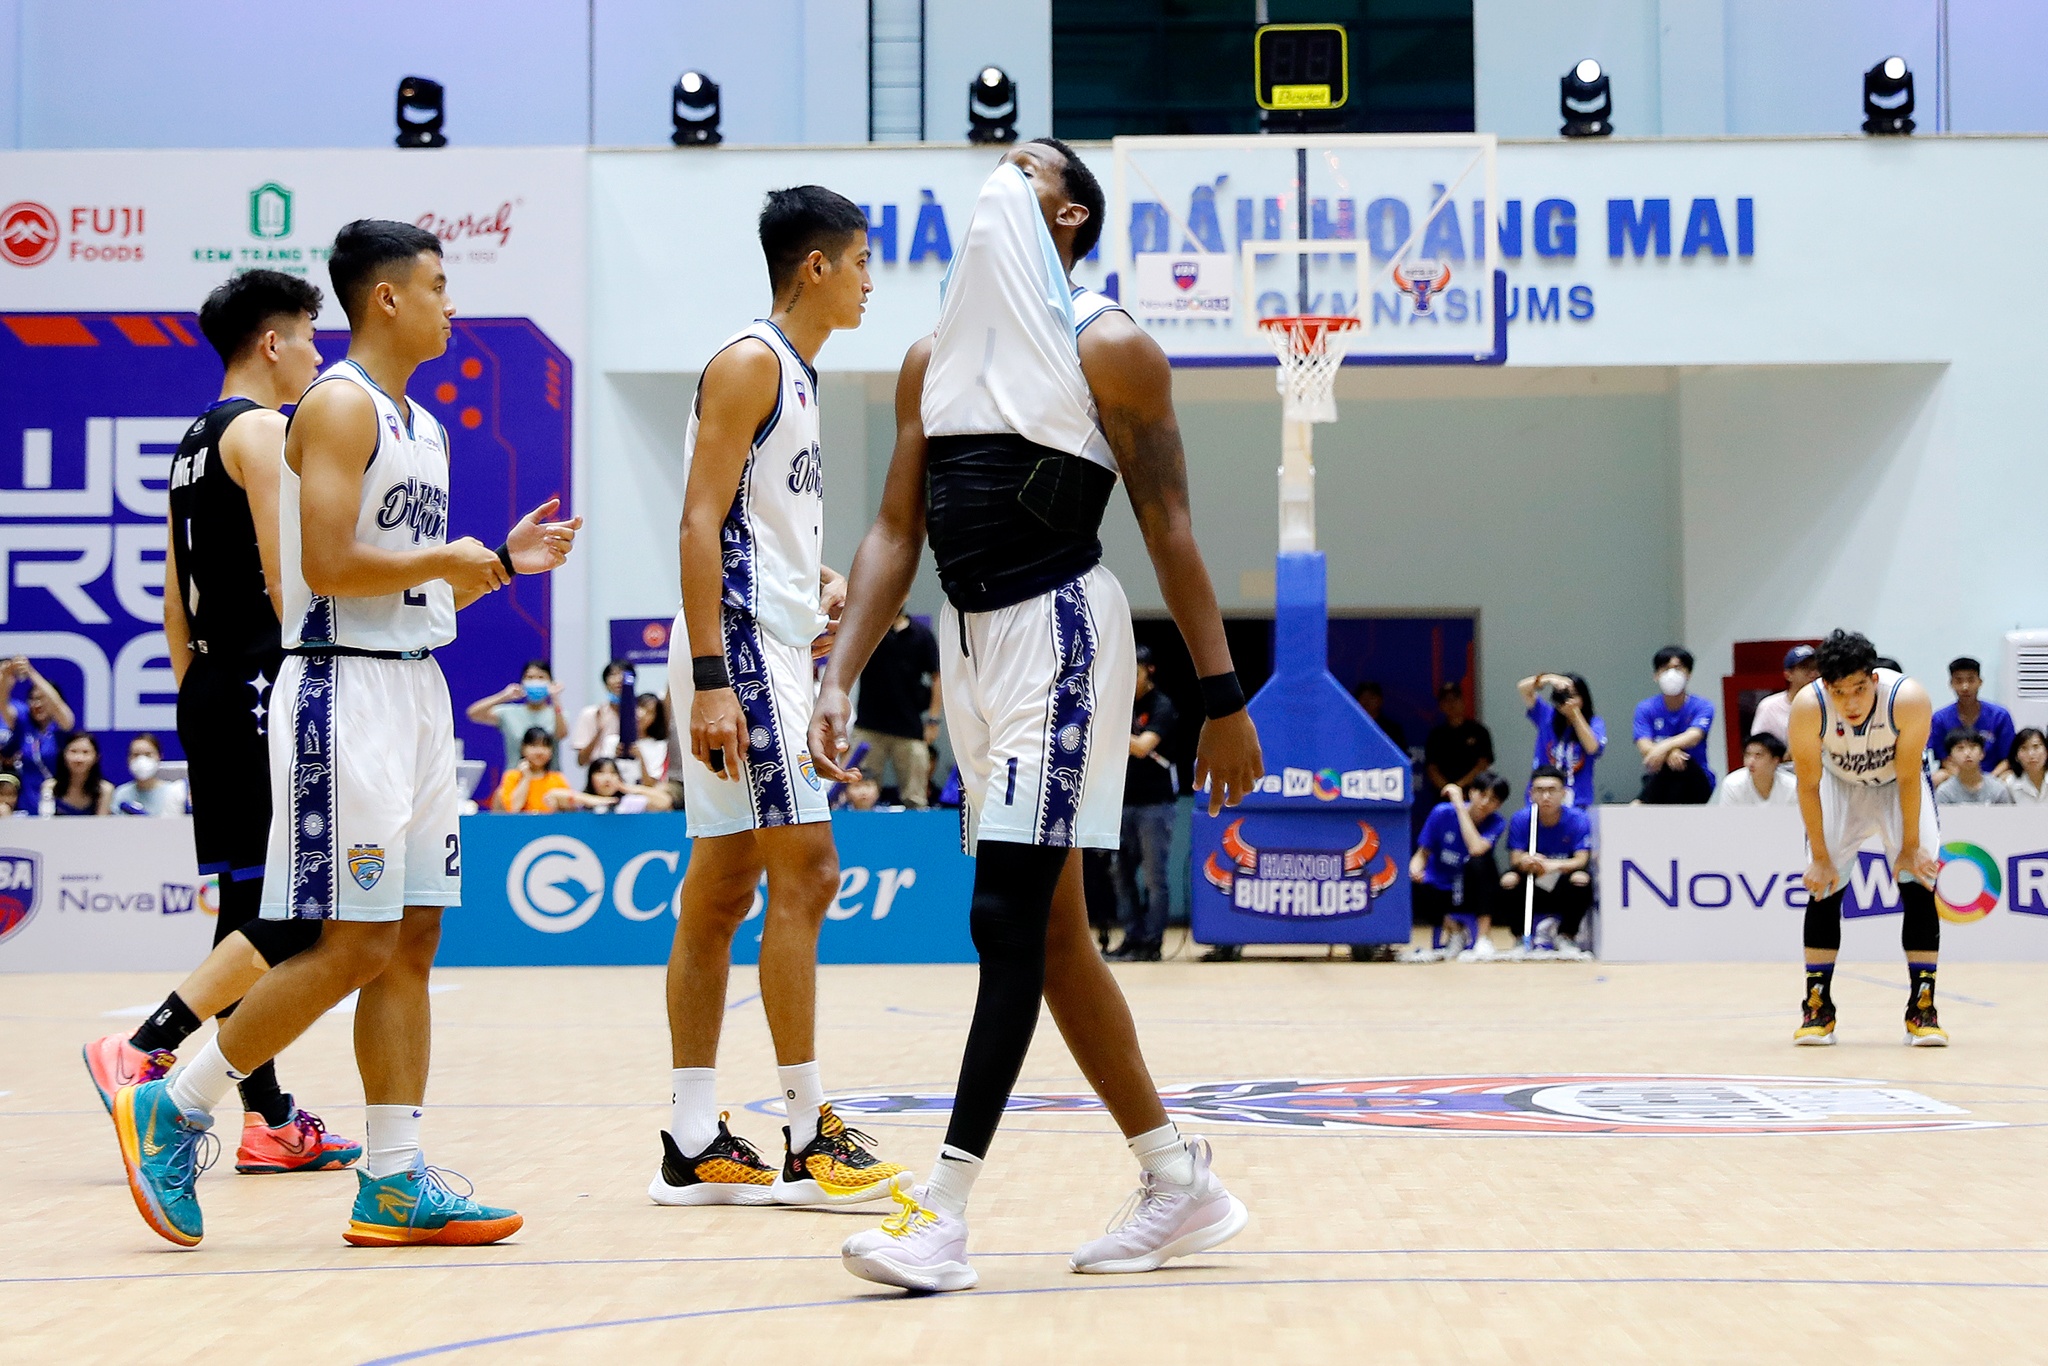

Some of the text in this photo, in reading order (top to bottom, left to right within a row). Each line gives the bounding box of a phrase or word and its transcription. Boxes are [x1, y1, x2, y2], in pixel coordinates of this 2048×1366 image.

[71, 208, 144, 236] FUJI
[859, 190, 953, 262] HÀ
[1311, 182, 1577, 258] HOÀNG
[1608, 198, 1754, 257] MAI
[1005, 757, 1017, 806] 1
[1195, 766, 1404, 802] vaWORLD
[445, 834, 459, 876] 2
[1259, 853, 1342, 880] HANOI
[612, 850, 915, 942] Cer
[1234, 879, 1369, 916] BUFFALOES
